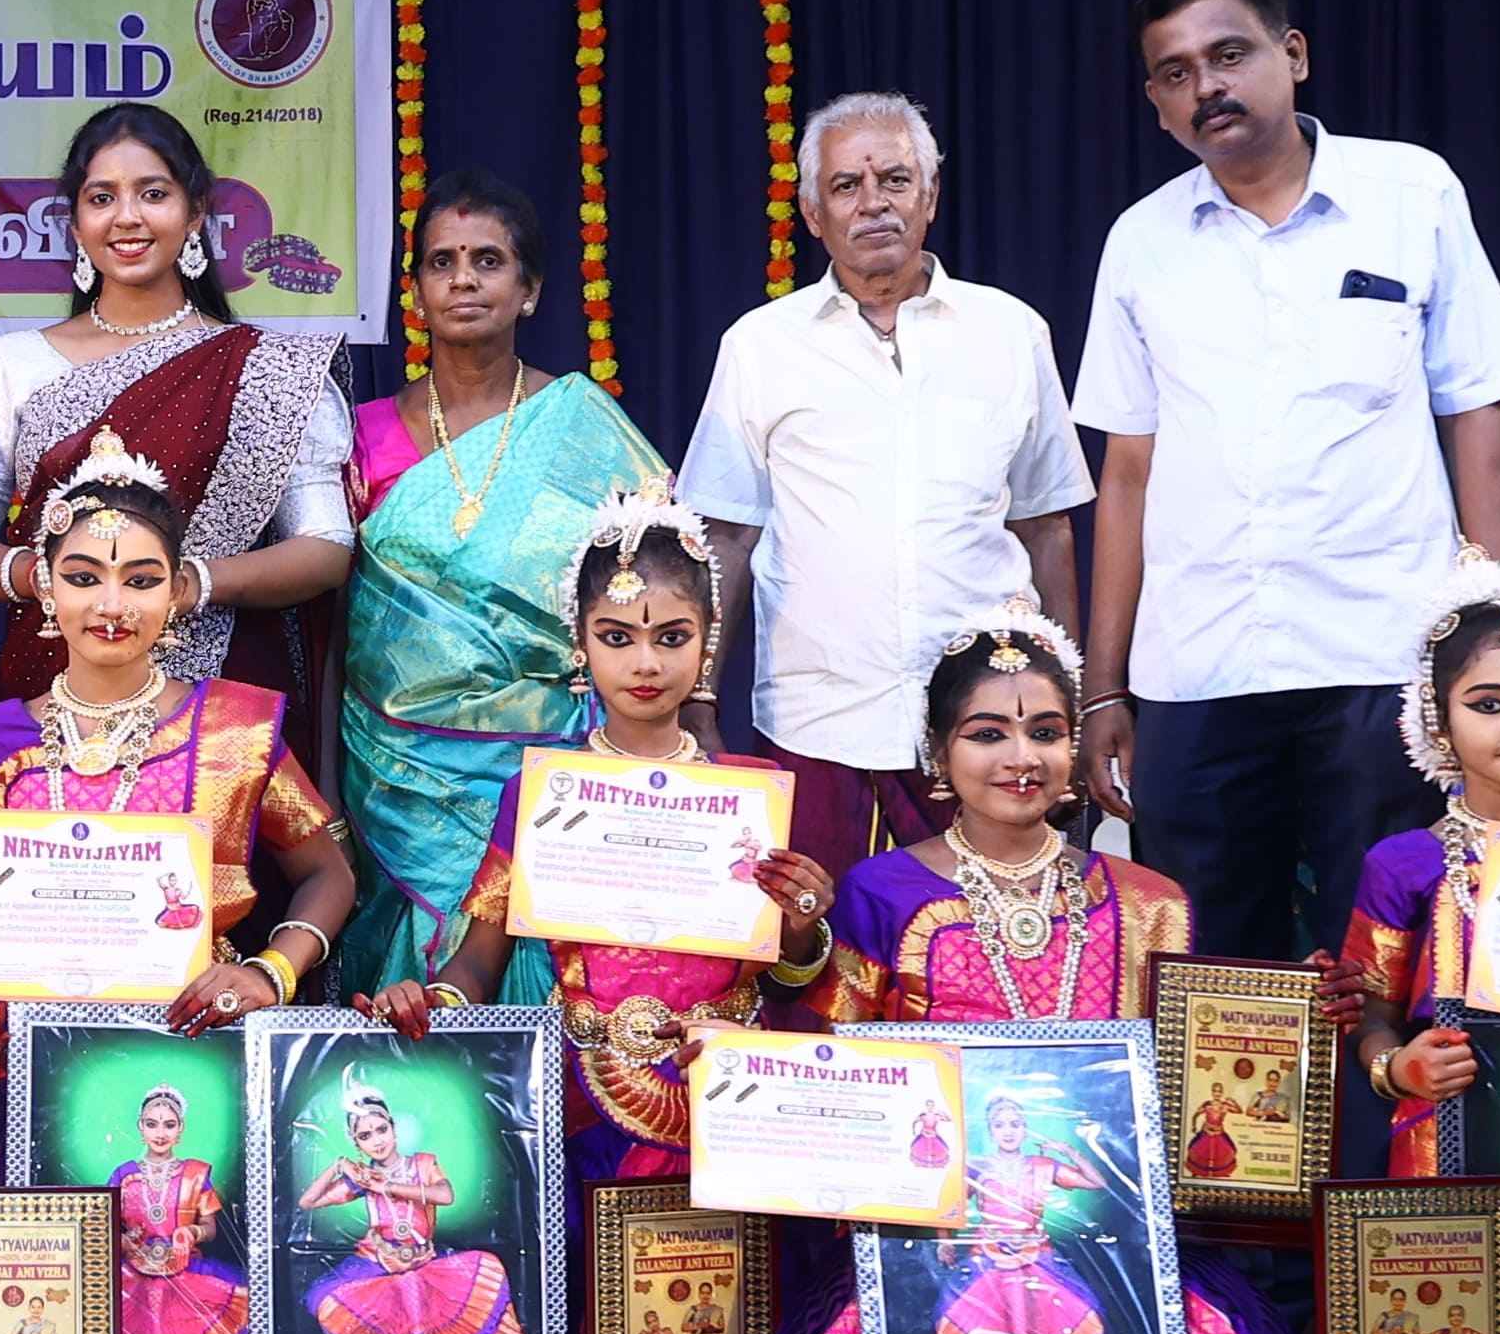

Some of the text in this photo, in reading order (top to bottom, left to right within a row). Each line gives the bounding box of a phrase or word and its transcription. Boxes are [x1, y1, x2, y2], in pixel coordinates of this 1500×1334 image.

[204, 107, 323, 126] (Reg.214/2018)
[578, 778, 739, 816] NATYAVIJAYAM
[3, 835, 162, 862] NATYAVIJAYAM
[746, 1054, 908, 1086] NATYAVIJAYAM
